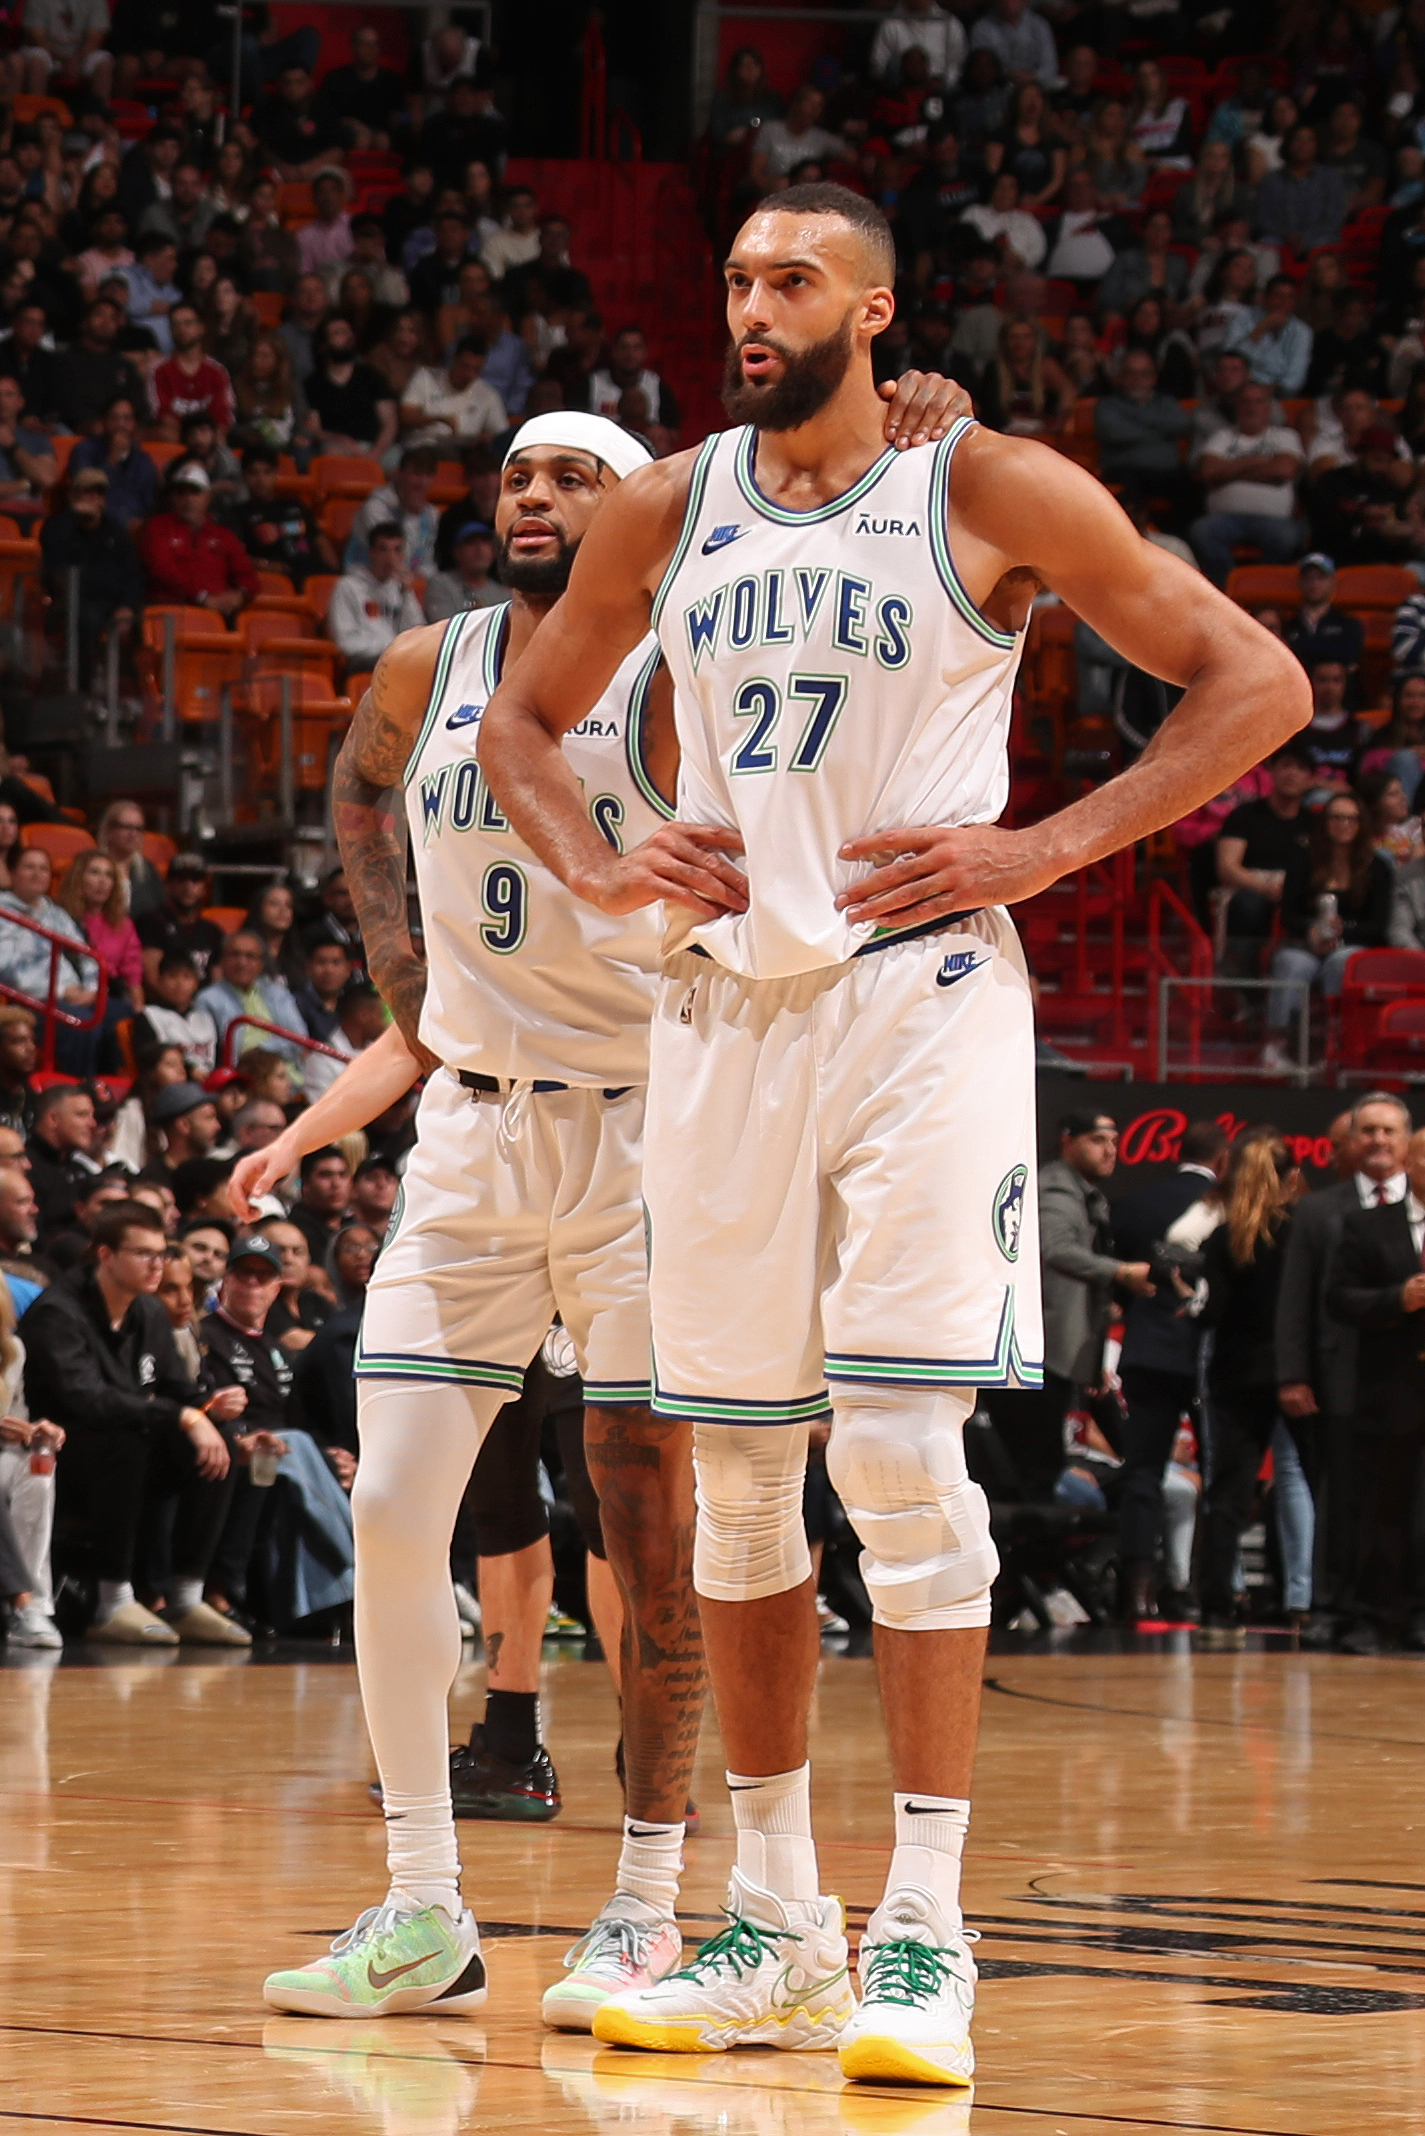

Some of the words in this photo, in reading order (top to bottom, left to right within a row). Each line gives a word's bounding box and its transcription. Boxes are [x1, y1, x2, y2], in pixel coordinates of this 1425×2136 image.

[708, 523, 742, 542] NIKE
[684, 567, 914, 678] WOLVES
[453, 702, 485, 719] NIKE
[568, 719, 620, 736] URA
[730, 672, 849, 776] 27
[419, 757, 626, 856] WOLS
[480, 860, 529, 956] 9
[943, 951, 976, 973] NIKE
